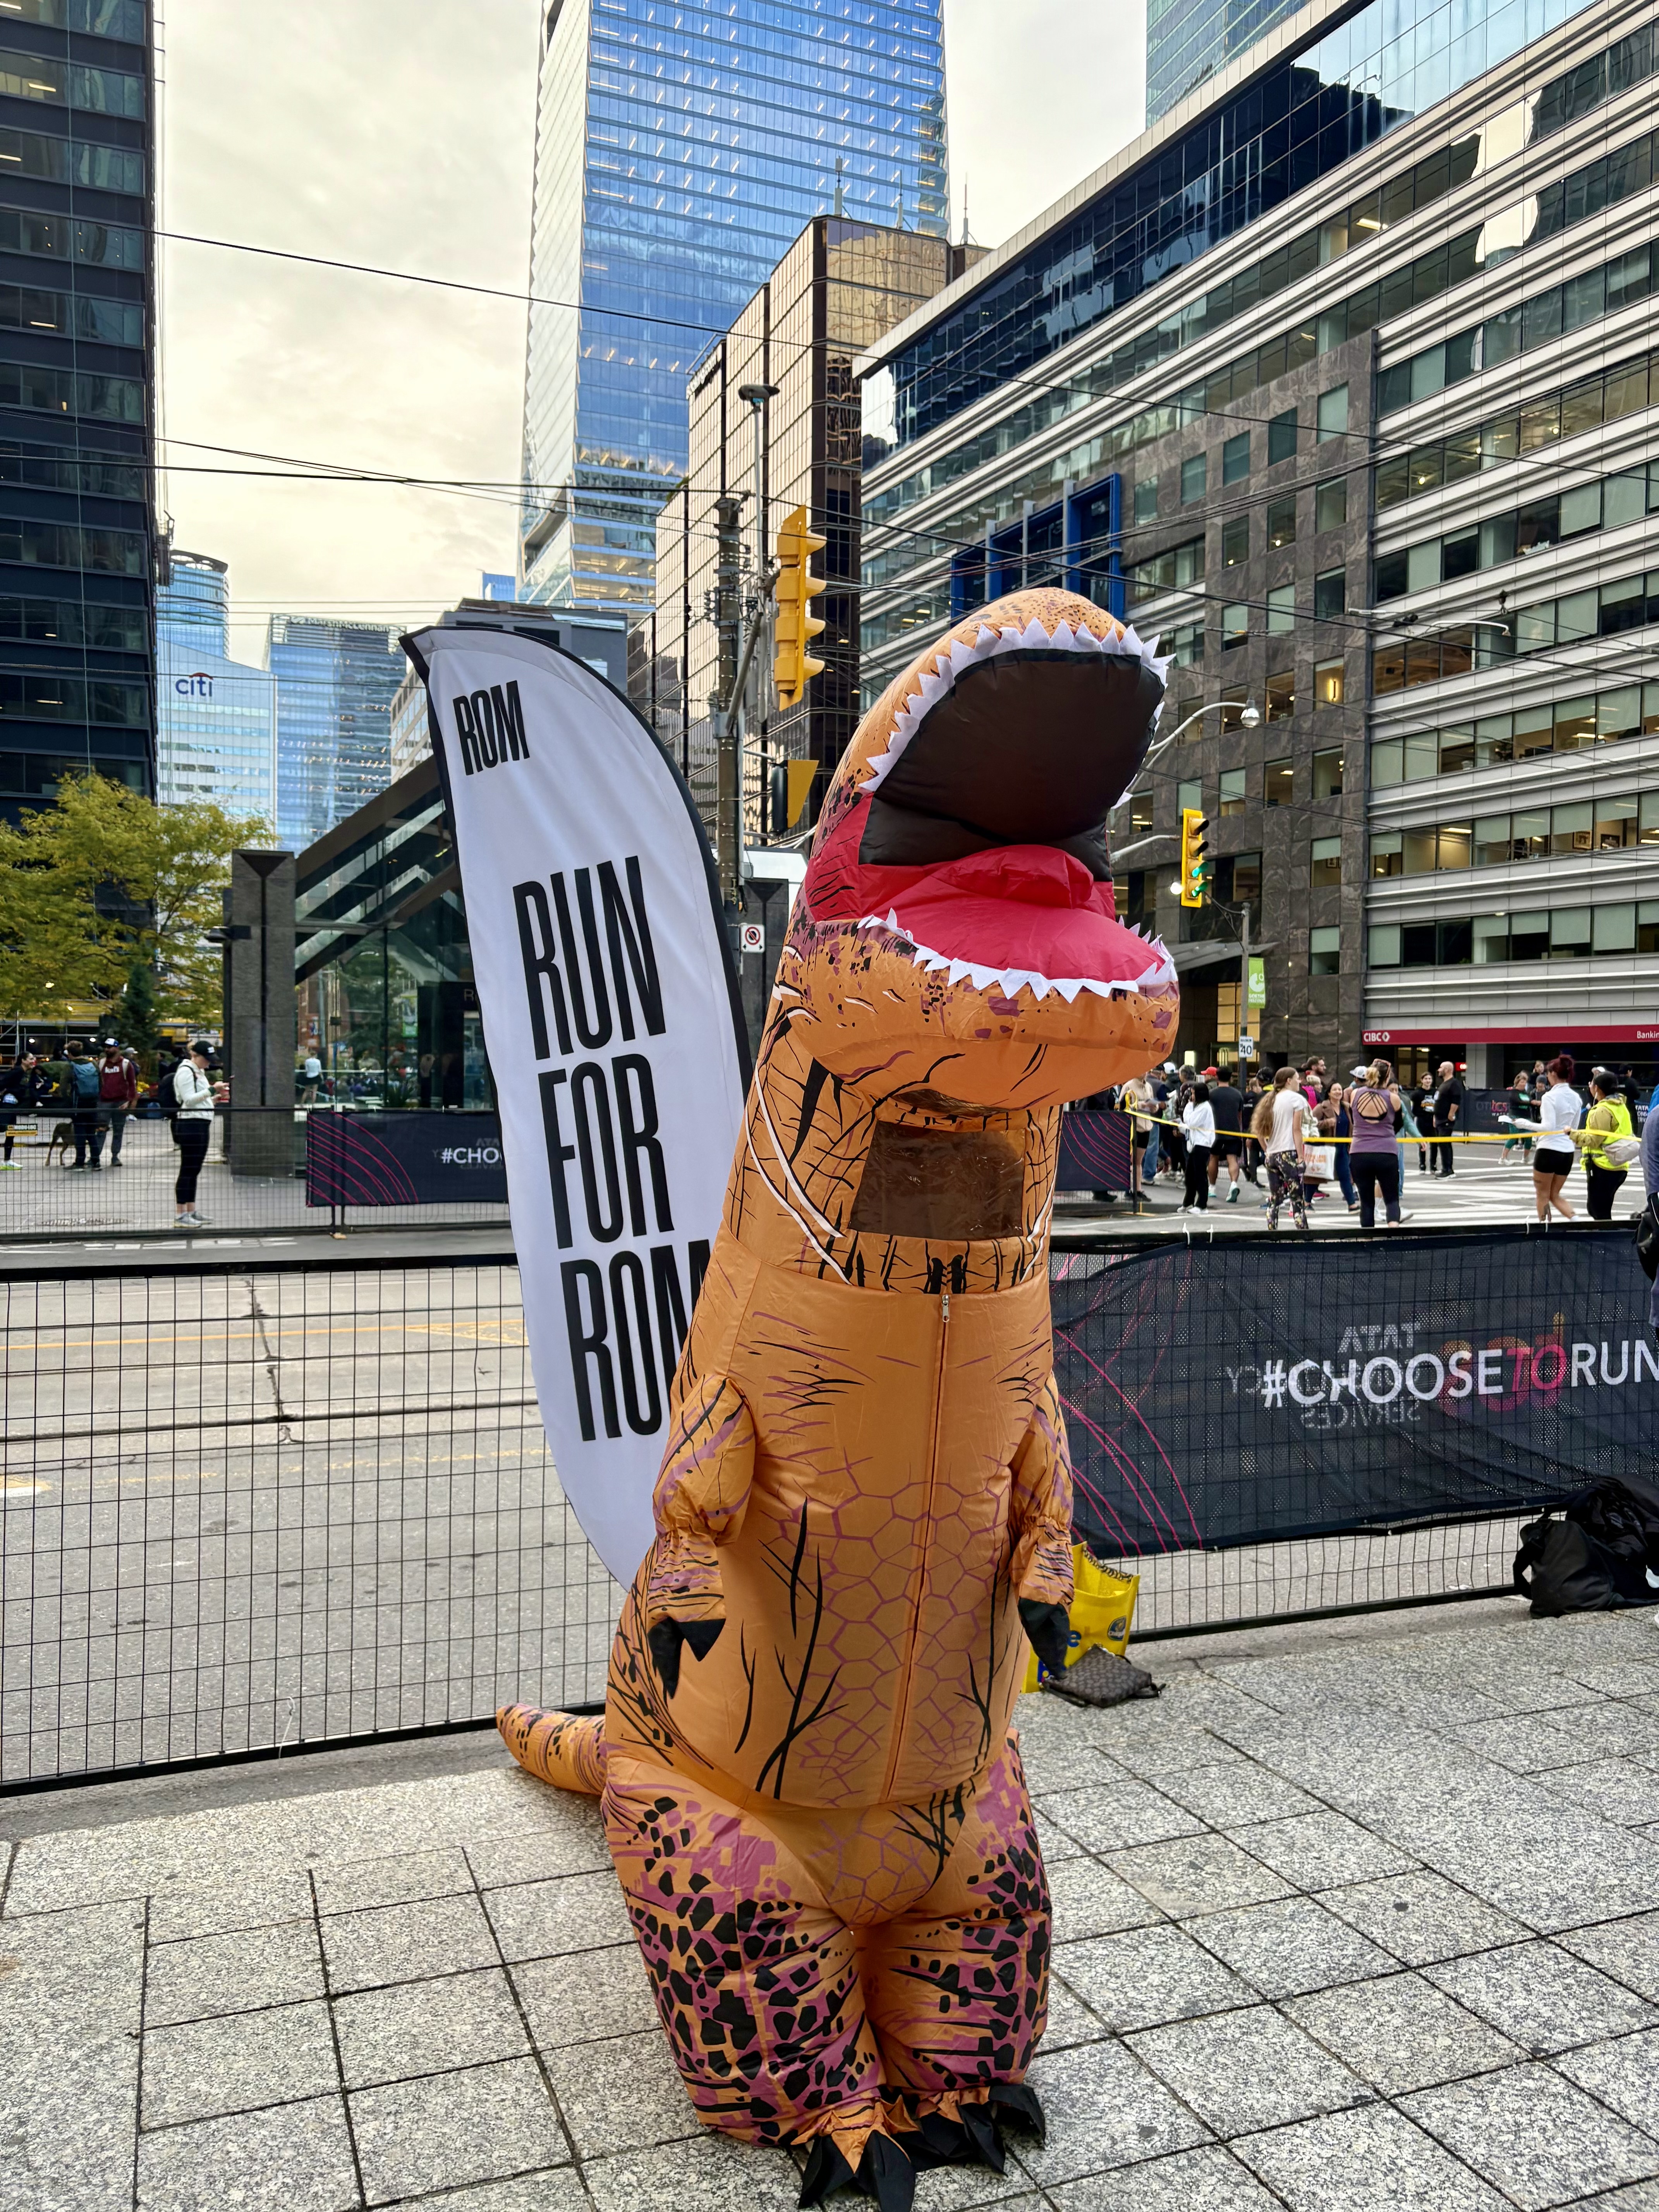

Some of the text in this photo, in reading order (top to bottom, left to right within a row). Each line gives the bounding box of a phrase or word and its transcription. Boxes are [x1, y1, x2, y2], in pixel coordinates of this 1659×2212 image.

[175, 674, 212, 697] citi
[453, 680, 530, 776] ROM
[513, 855, 666, 1060] RUN
[1364, 1032, 1381, 1042] CIBC
[1240, 1045, 1252, 1055] 40
[441, 1147, 502, 1164] #CHO
[538, 1053, 675, 1249] FOR
